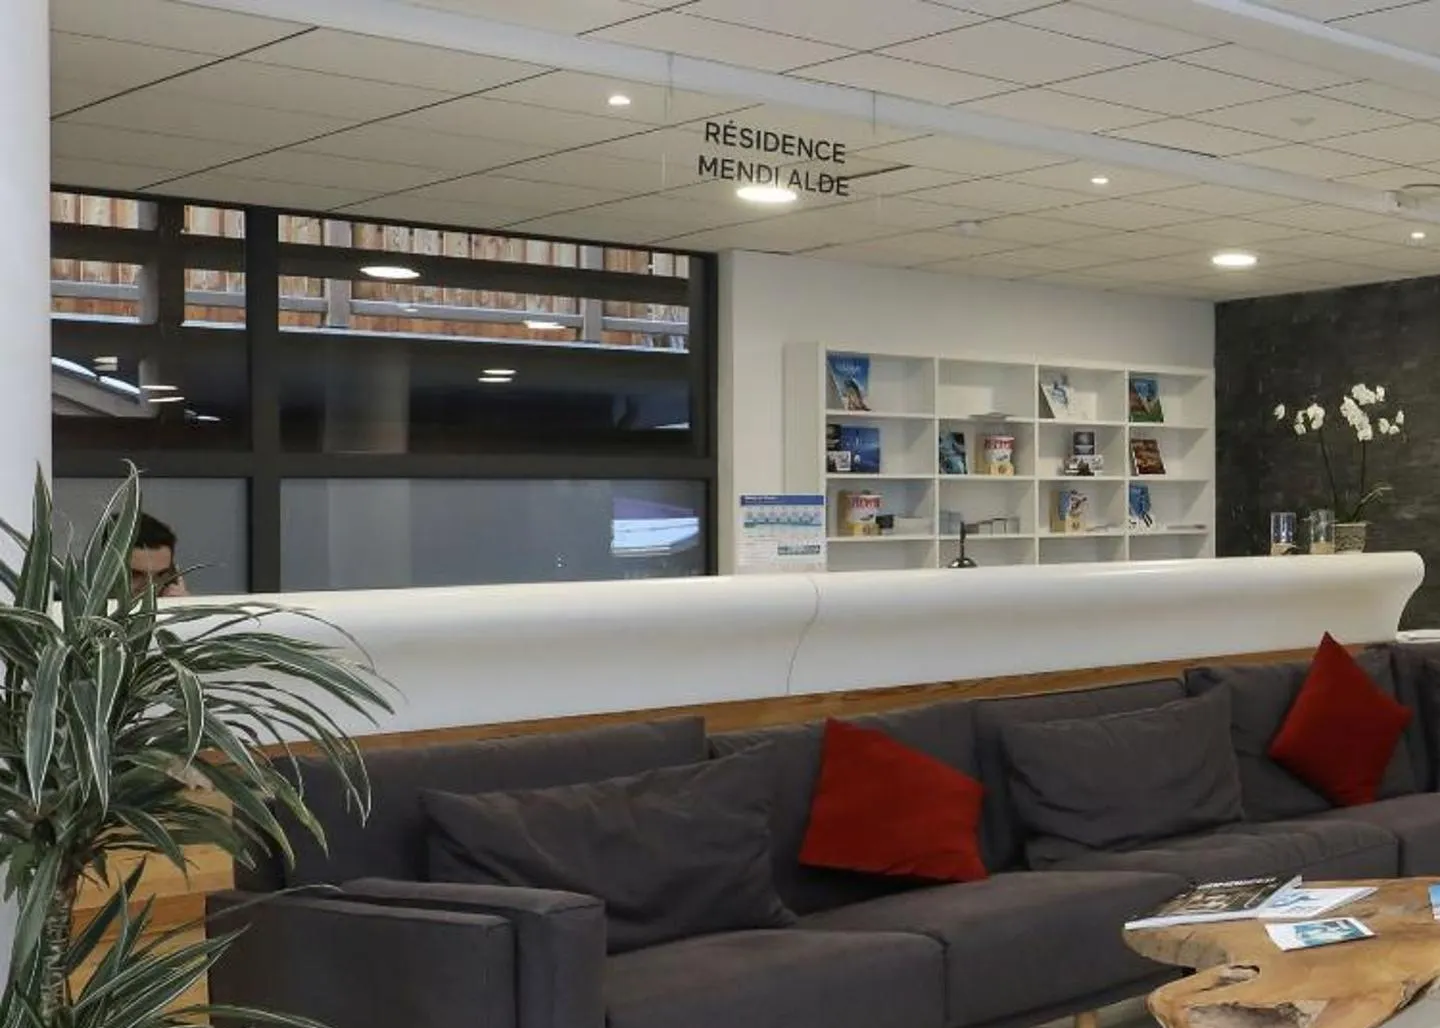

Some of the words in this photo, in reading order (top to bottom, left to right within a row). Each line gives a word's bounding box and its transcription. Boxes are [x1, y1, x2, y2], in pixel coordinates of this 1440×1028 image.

[704, 120, 846, 164] RÉSIDENCE
[698, 155, 779, 186] MENDI
[787, 168, 849, 197] ALDE
